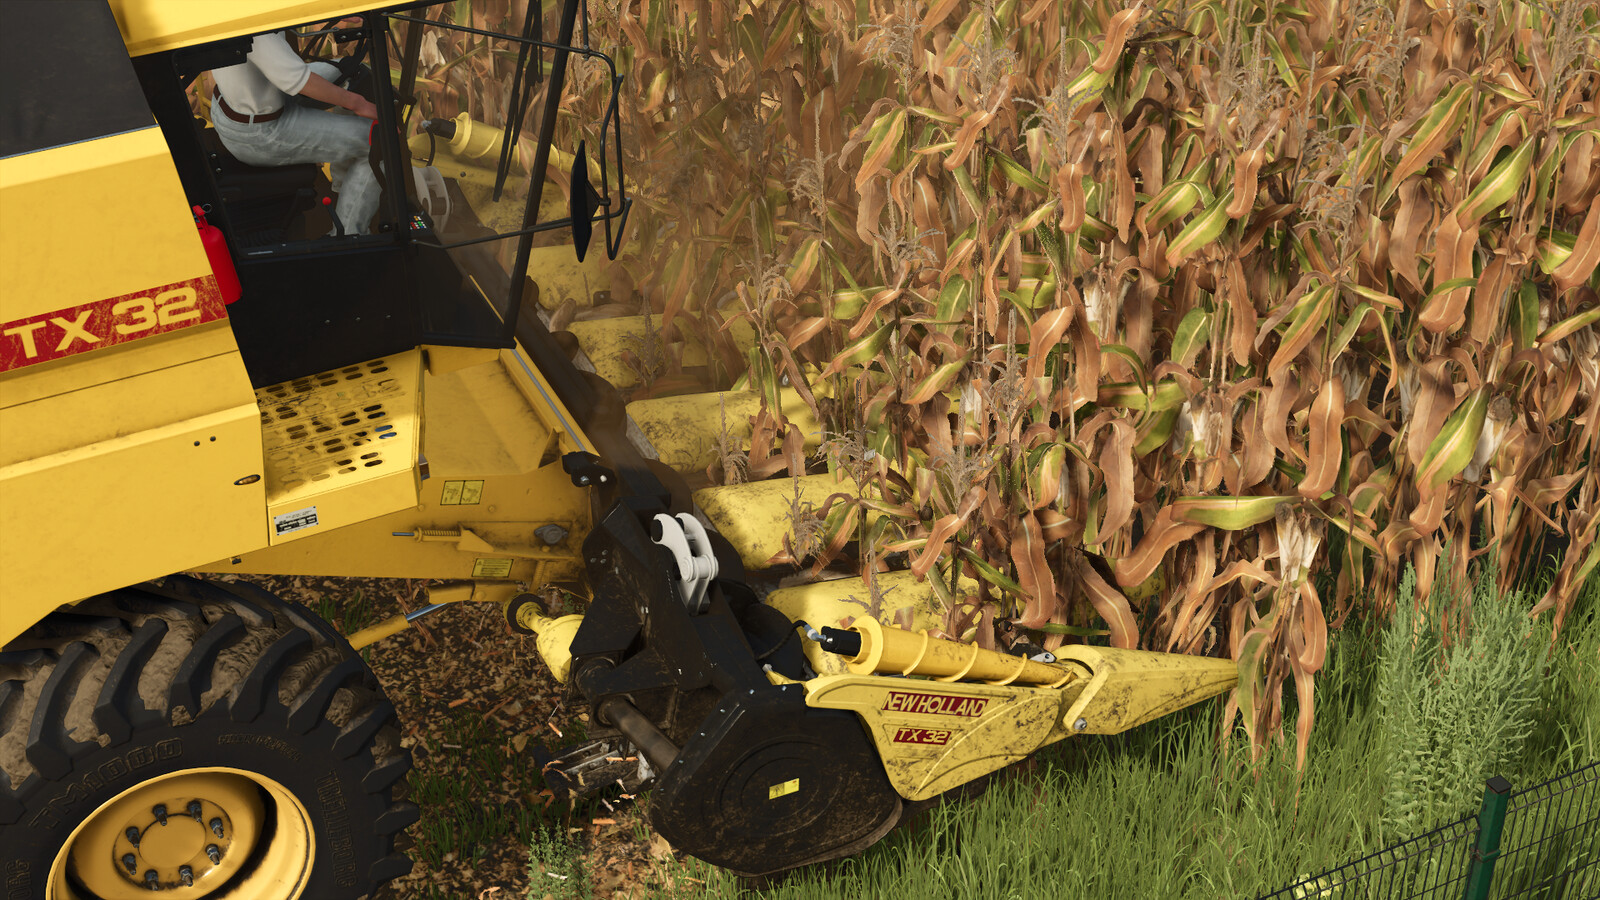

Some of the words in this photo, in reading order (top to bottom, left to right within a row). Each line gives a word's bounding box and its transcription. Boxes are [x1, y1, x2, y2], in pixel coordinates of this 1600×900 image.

[3, 309, 101, 359] TX
[111, 286, 201, 335] 32
[898, 728, 922, 742] TX
[922, 730, 949, 743] 32
[314, 769, 358, 888] TRELLEBORG
